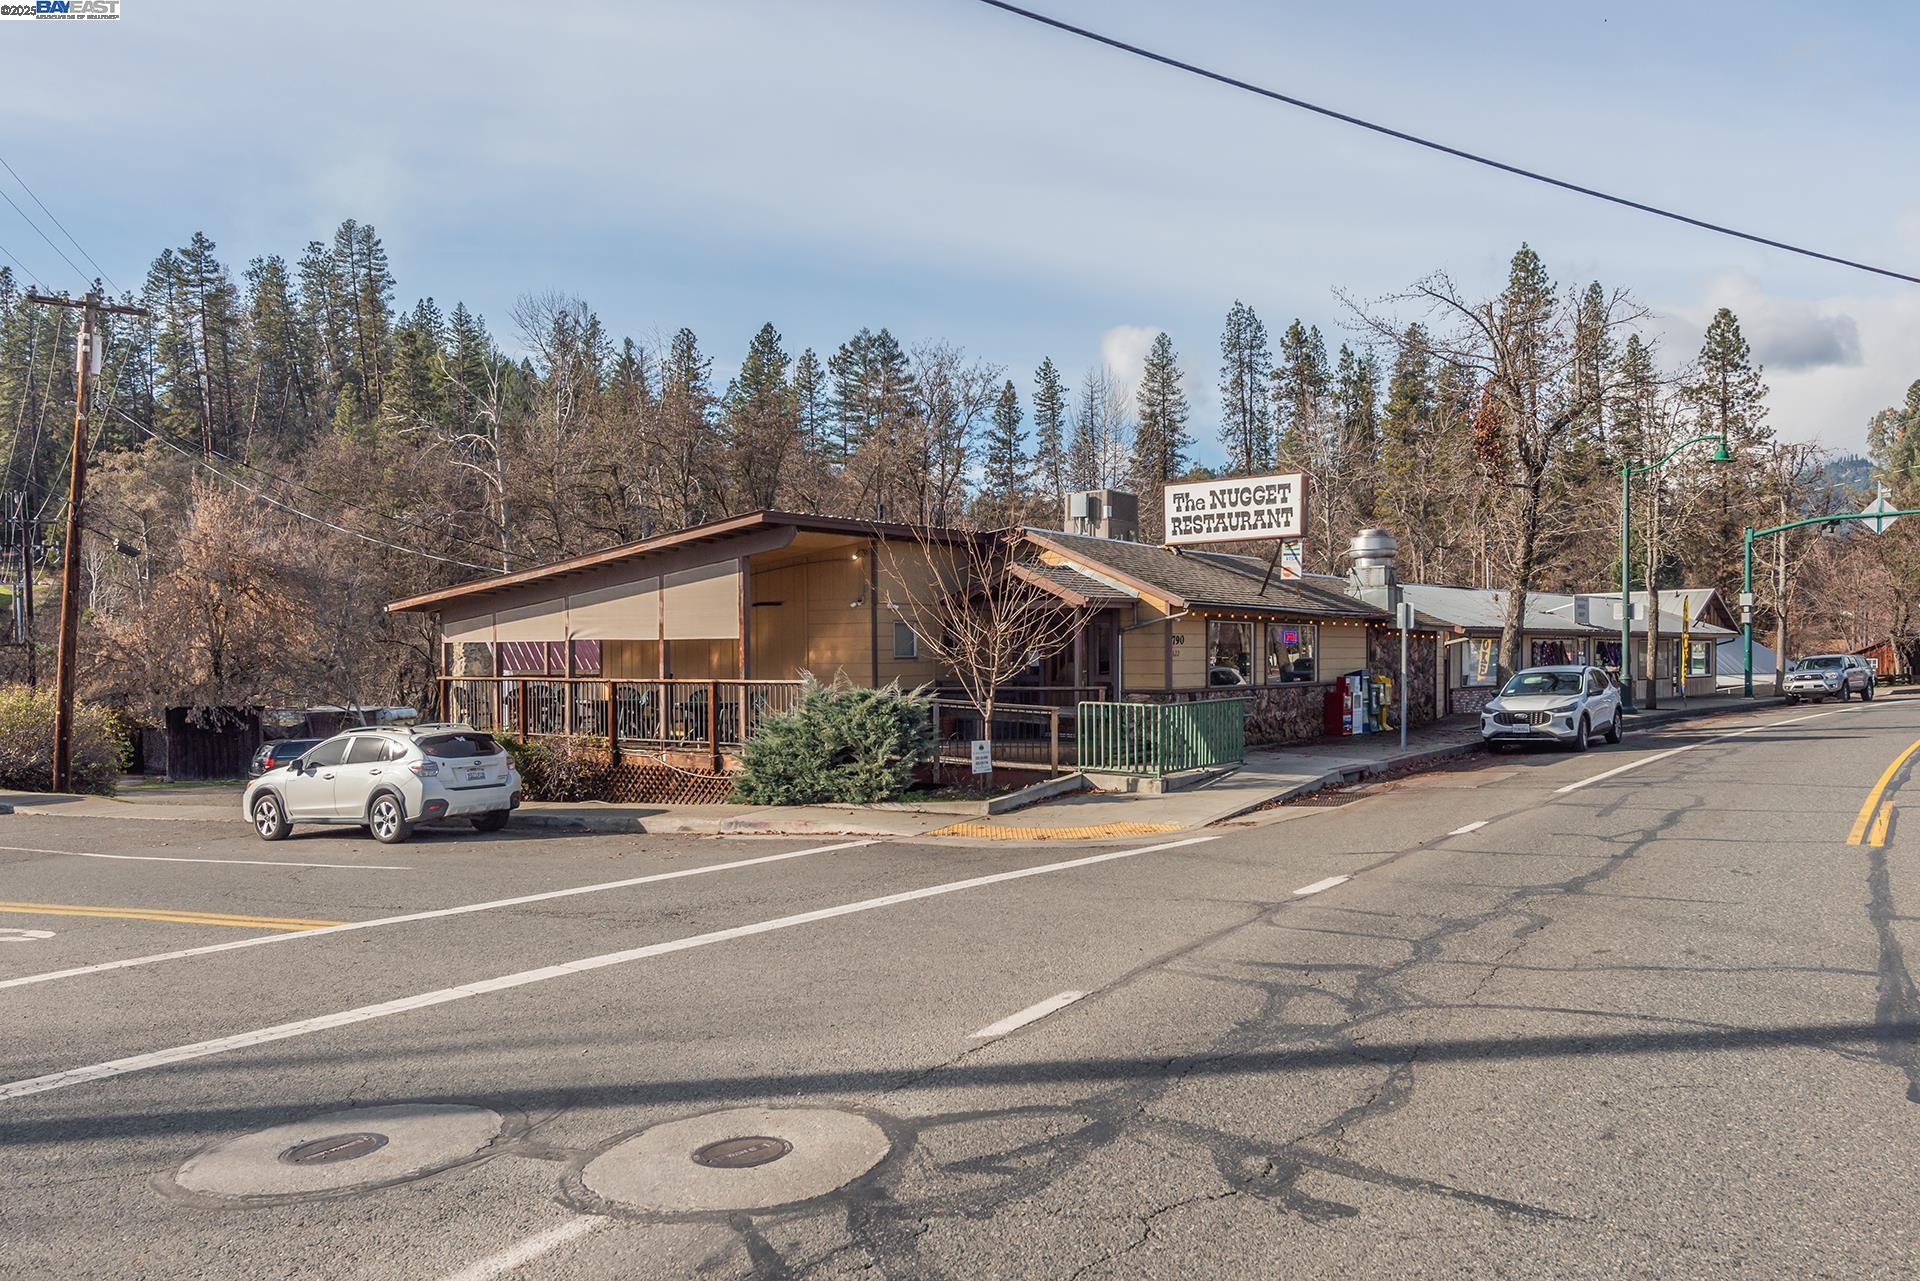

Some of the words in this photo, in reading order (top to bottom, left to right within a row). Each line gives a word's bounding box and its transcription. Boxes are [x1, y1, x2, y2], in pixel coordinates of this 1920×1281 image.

[1173, 492, 1206, 512] The
[1209, 483, 1291, 509] NUGGET
[1171, 507, 1294, 536] RESTAURANT
